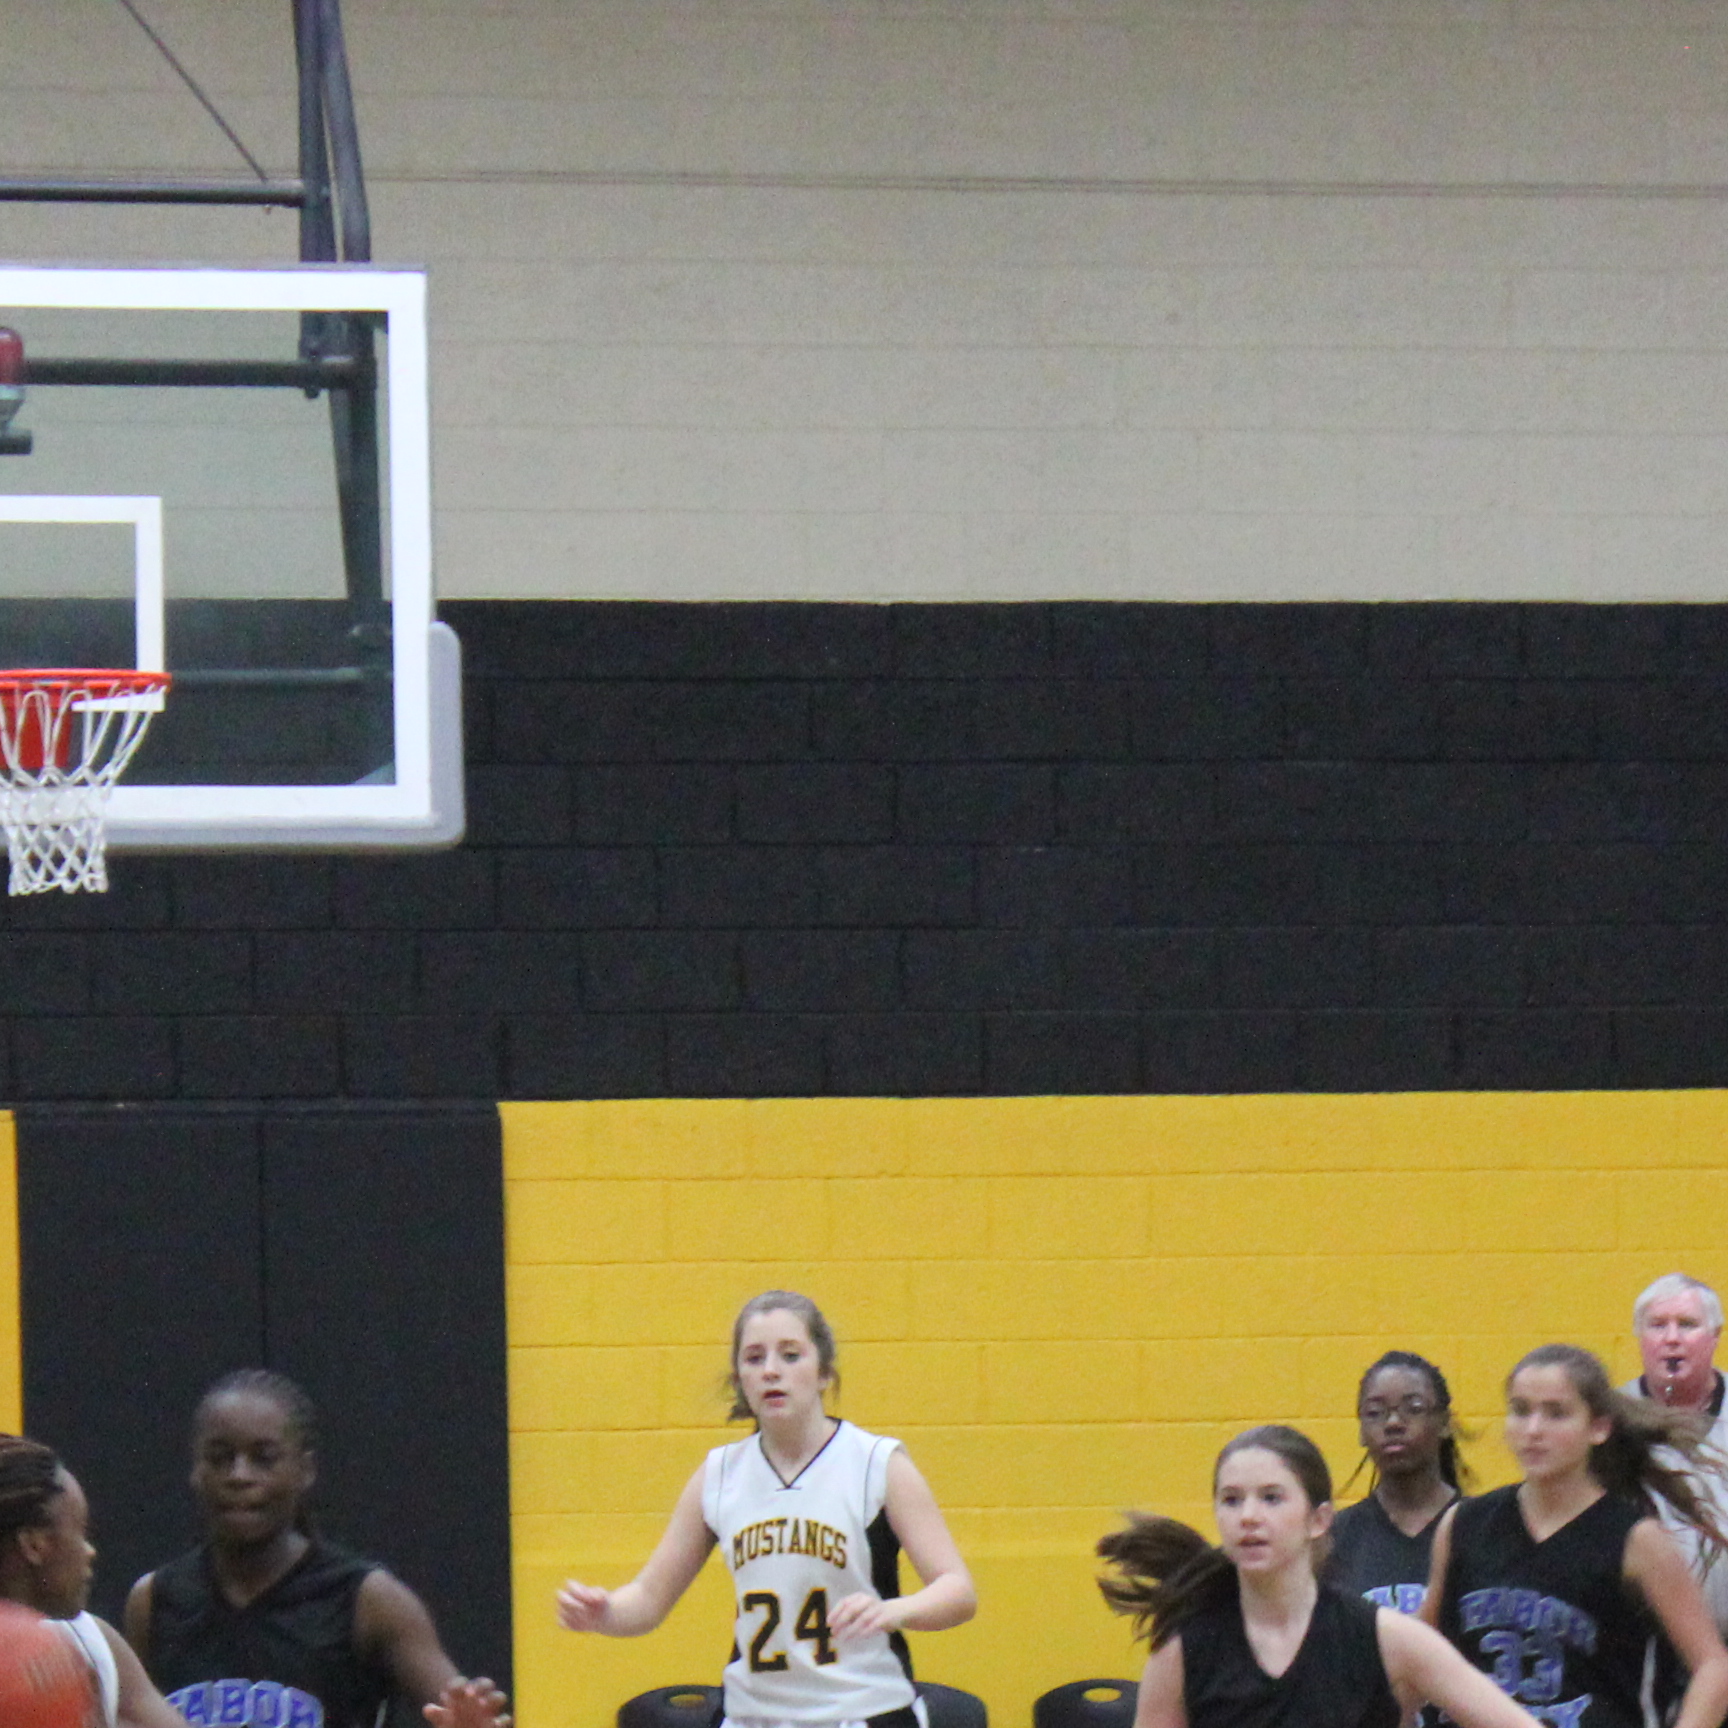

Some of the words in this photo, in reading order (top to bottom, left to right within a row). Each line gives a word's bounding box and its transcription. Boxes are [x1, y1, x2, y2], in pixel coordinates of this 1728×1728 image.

[732, 1516, 849, 1572] MUSTANGS
[742, 1586, 840, 1674] 24
[1478, 1629, 1565, 1702] 33
